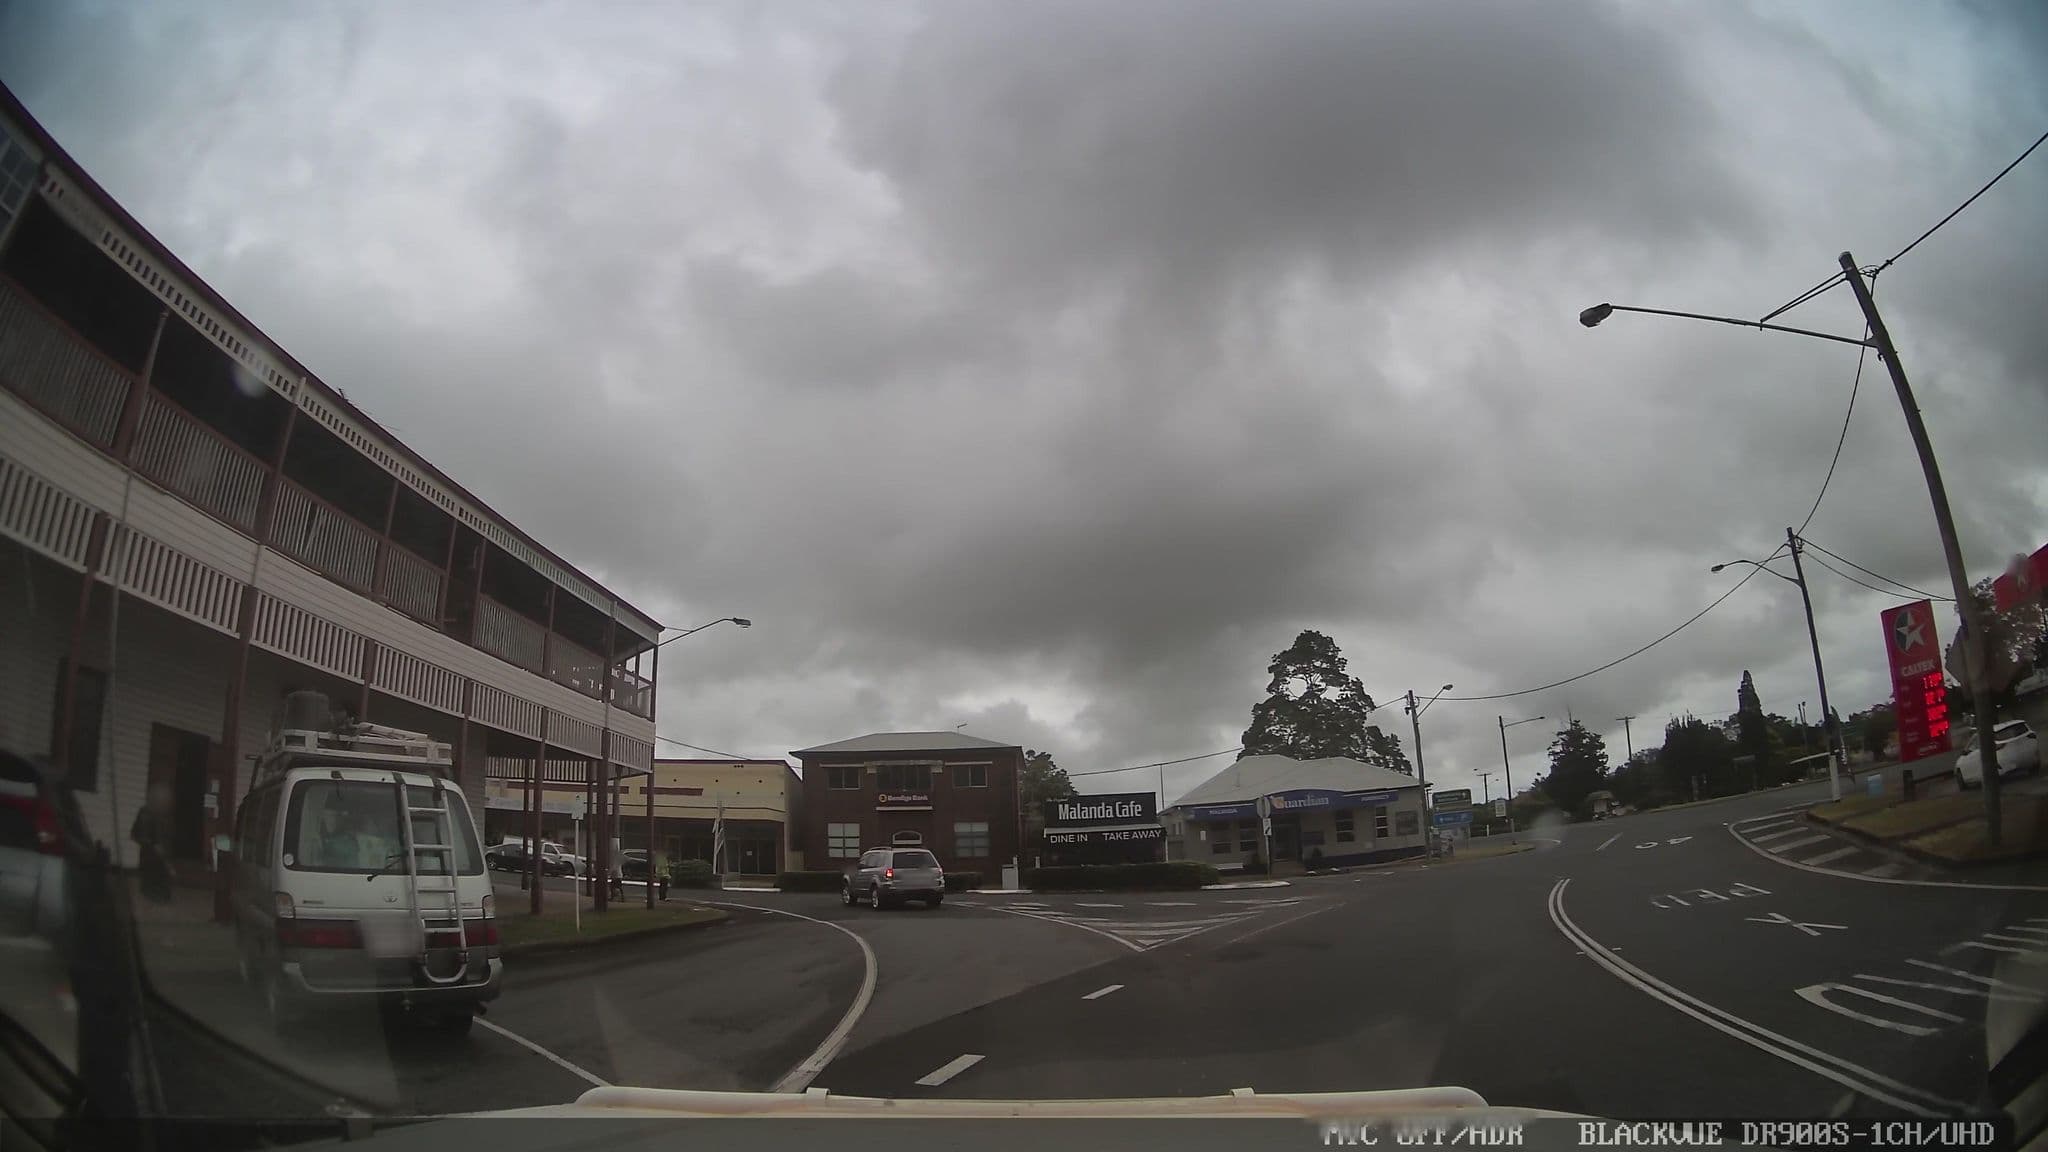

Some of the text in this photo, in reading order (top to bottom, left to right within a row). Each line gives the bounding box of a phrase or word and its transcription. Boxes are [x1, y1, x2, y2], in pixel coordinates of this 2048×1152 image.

[1058, 800, 1142, 820] Malanda Cafe
[1050, 834, 1089, 843] DINE IN
[1102, 830, 1162, 841] TAKE AWAY
